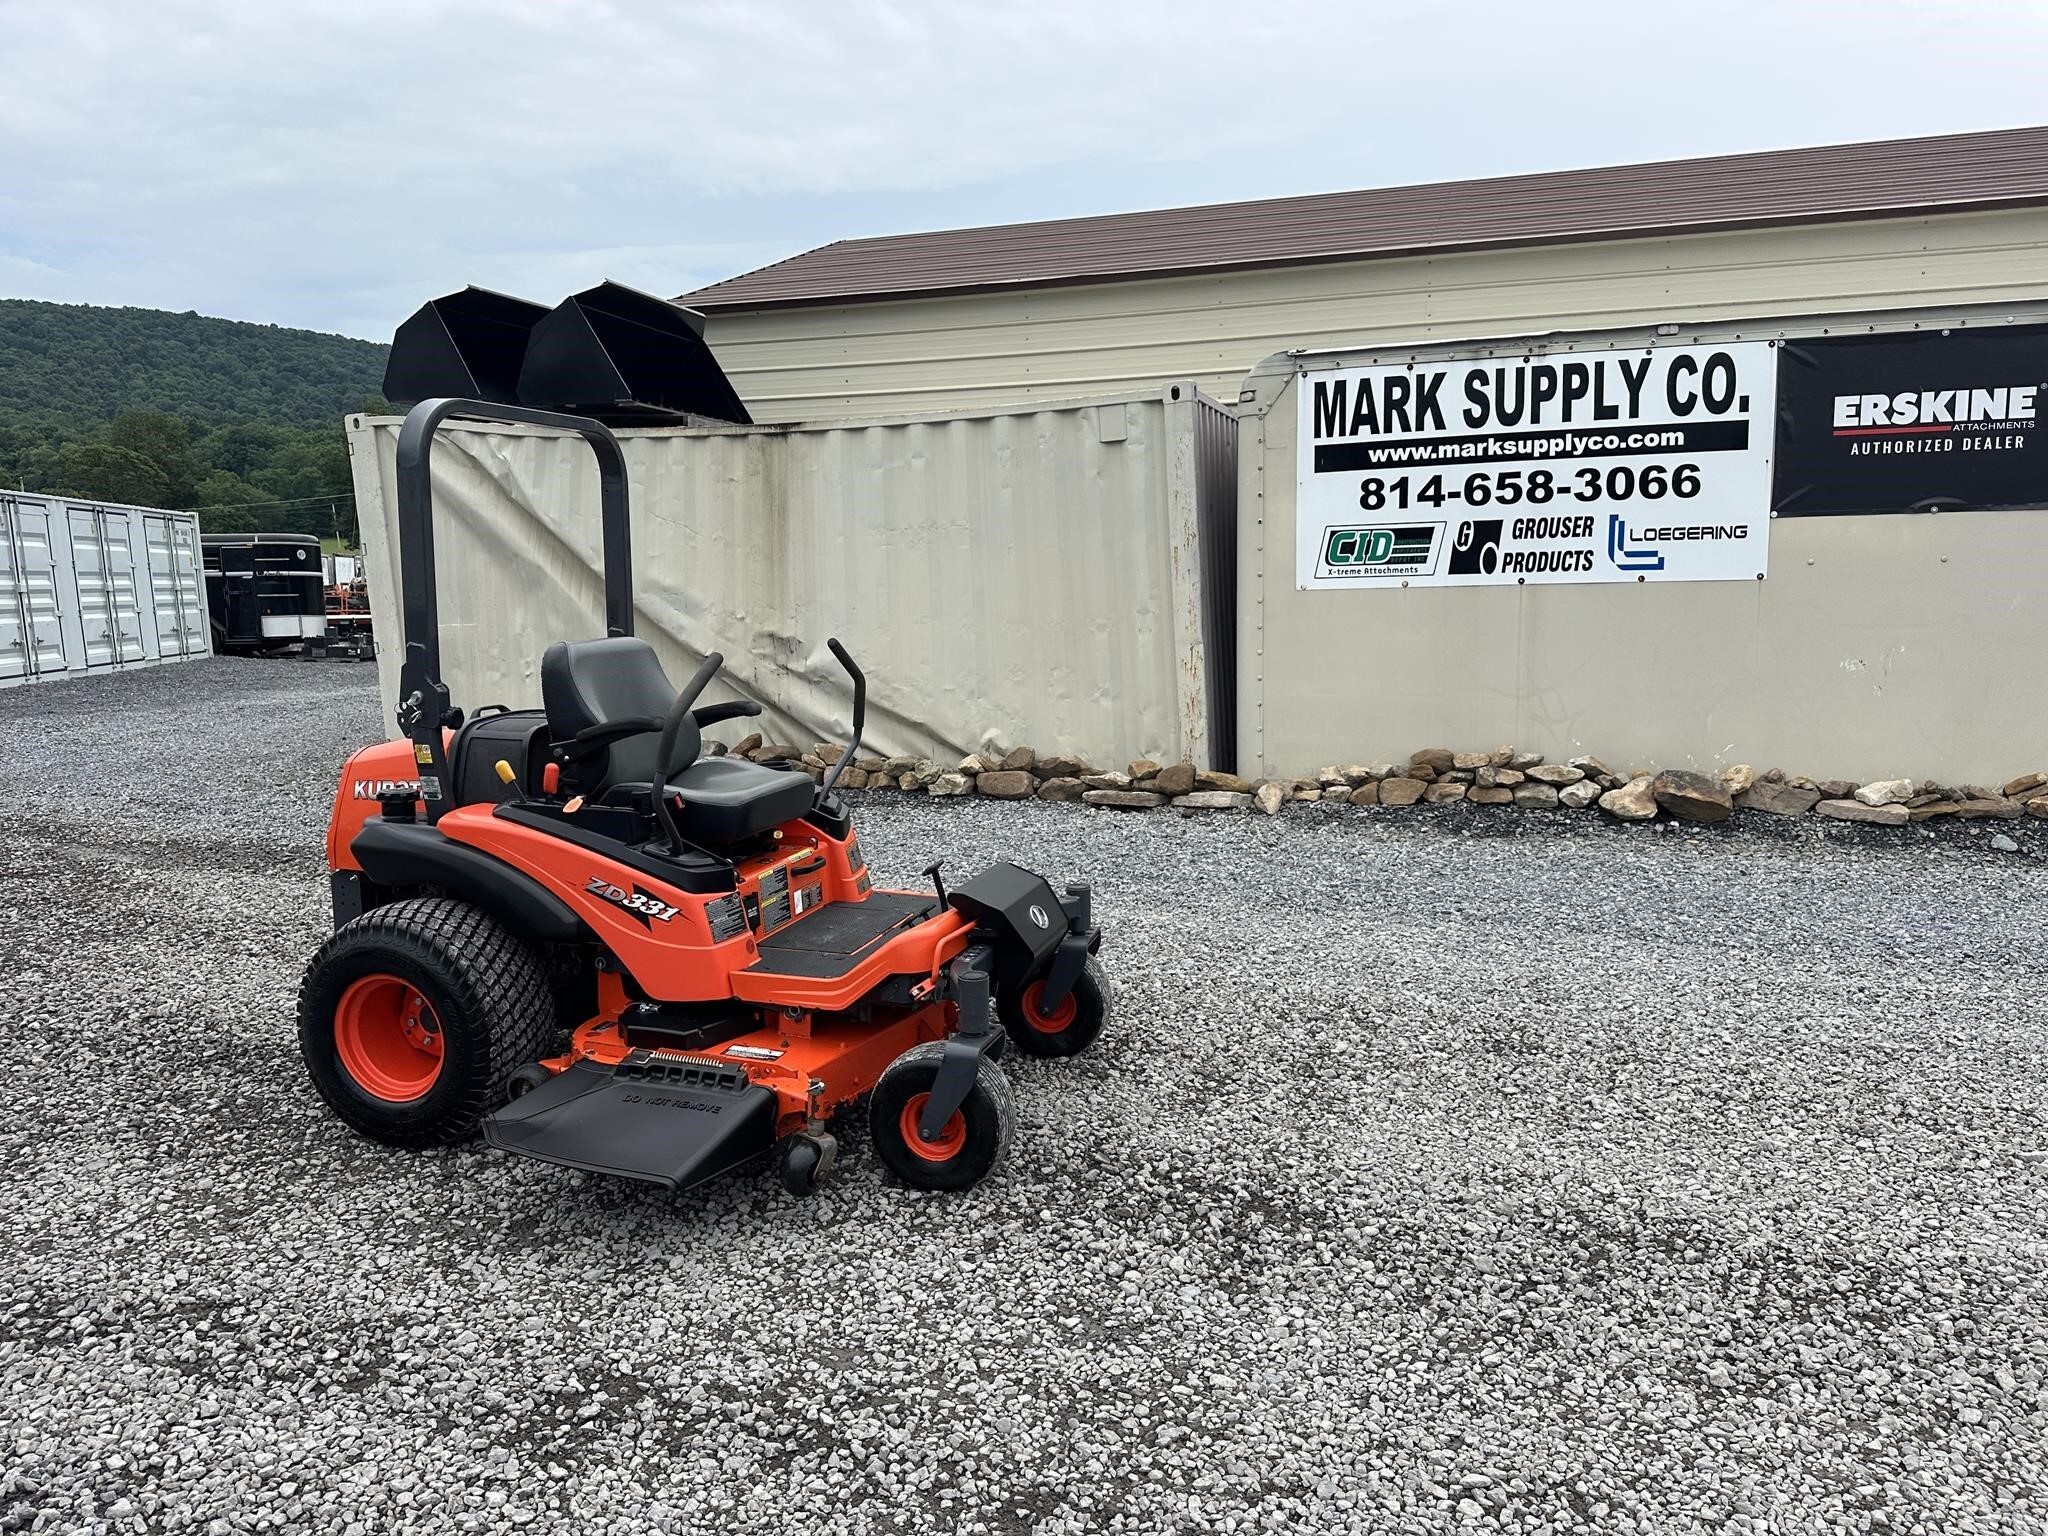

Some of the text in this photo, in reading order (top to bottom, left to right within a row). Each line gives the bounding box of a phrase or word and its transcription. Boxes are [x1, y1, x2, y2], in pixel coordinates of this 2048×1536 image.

[1314, 352, 1750, 438] MARK SUPPLY CO.
[1833, 386, 2038, 427] ERSKINE
[1953, 420, 2036, 431] ATTACHMENTS
[1368, 430, 1685, 463] www.marksupplyco.com
[1850, 435, 2025, 456] AUTHORIZED DEALER
[1359, 463, 1702, 511] 814-658-3066
[1511, 515, 1595, 540] GROUSER
[1629, 525, 1748, 542] LOEGERING
[1329, 531, 1394, 564] CID
[1327, 568, 1362, 576] X-treme
[1501, 549, 1594, 574] PRODUCTS
[585, 876, 681, 922] ZD331
[622, 1094, 722, 1114] DO NOT REMOVE
